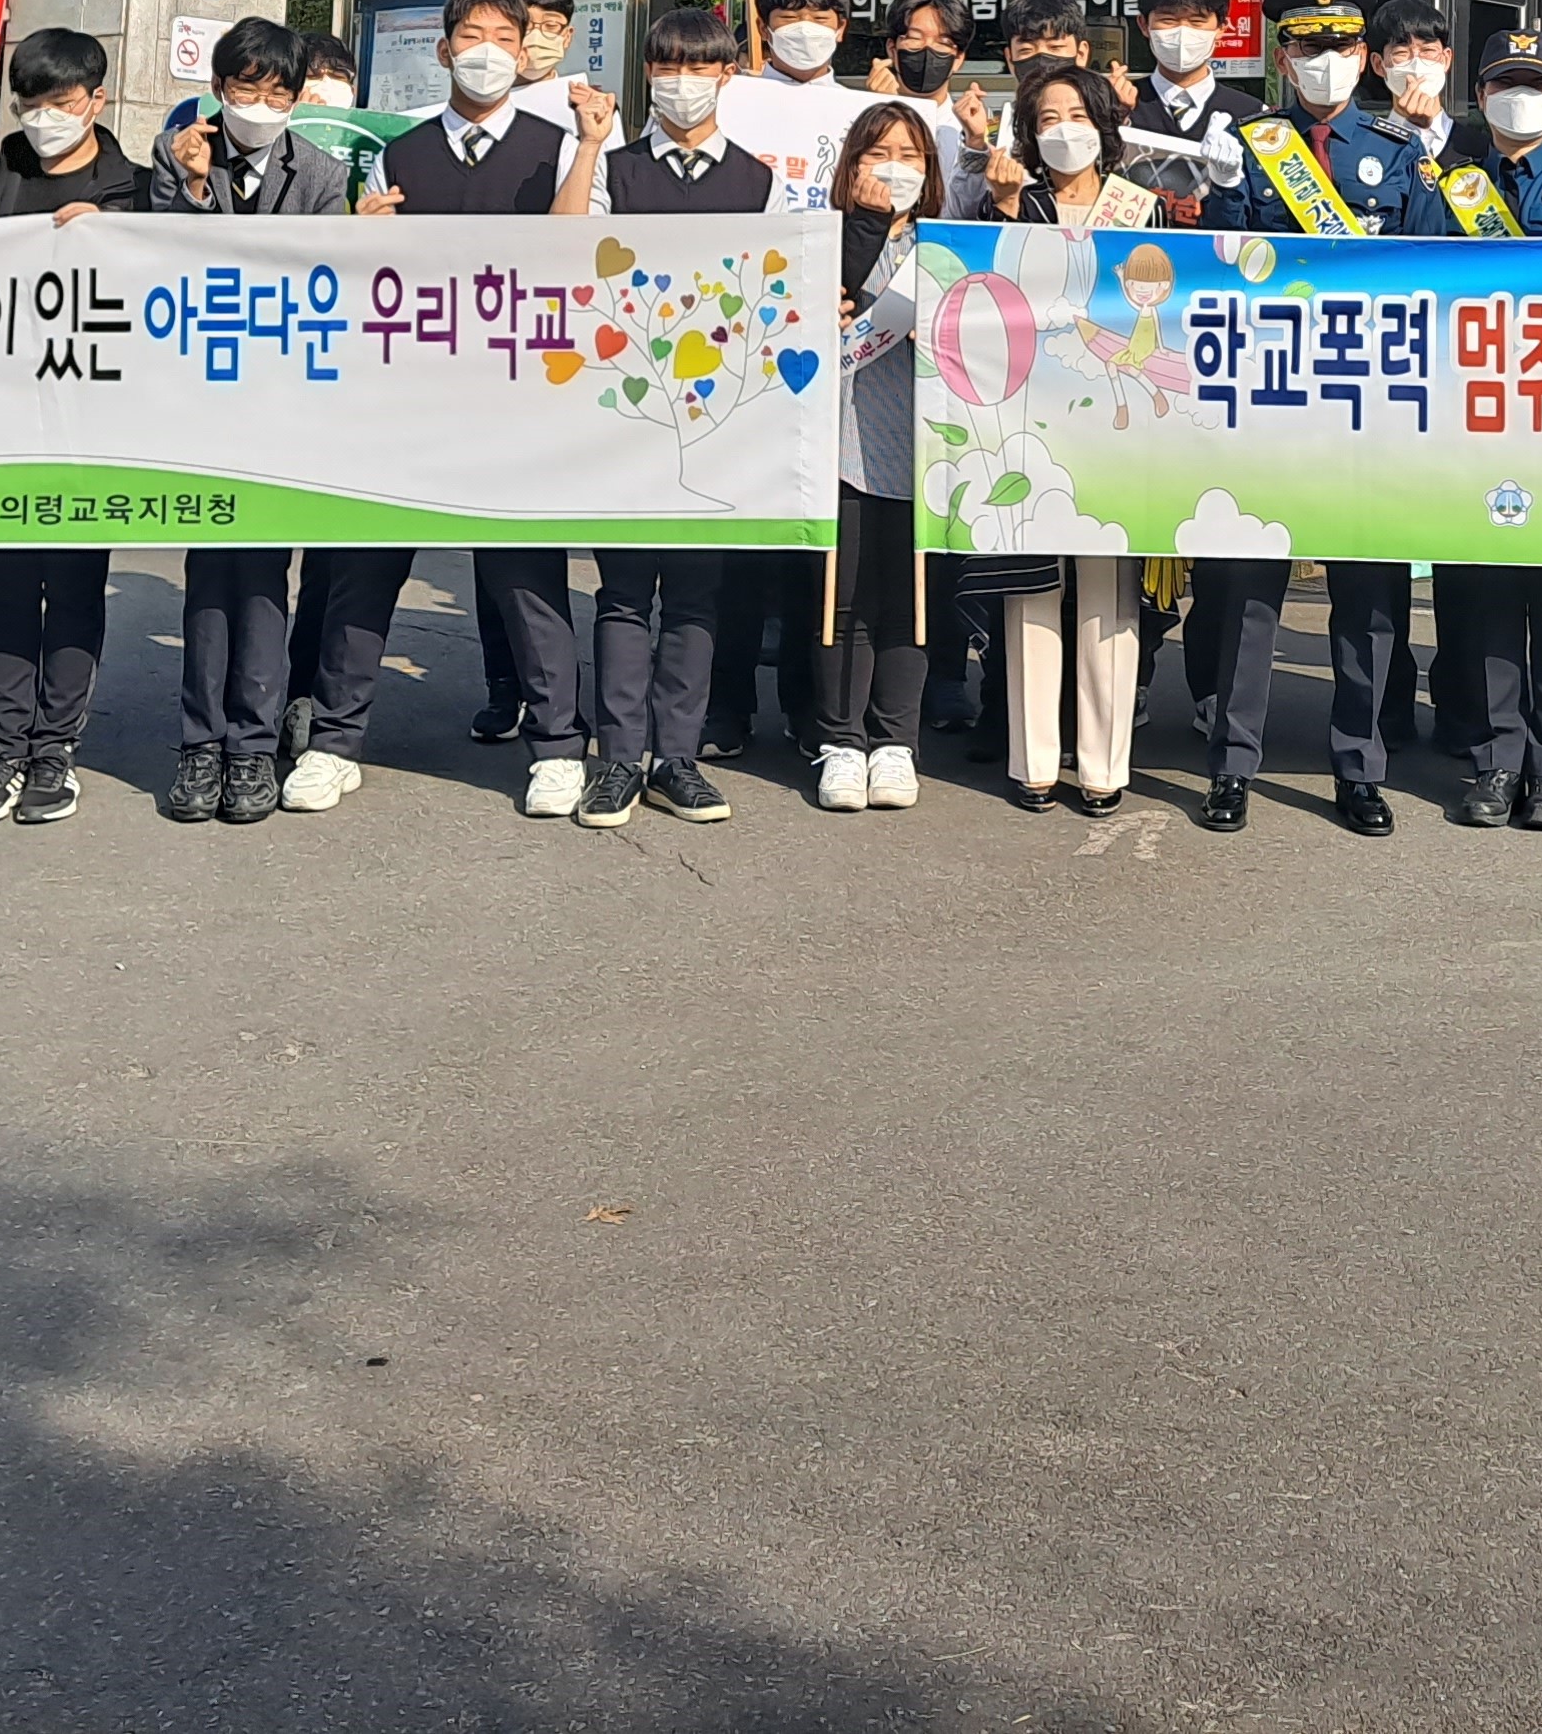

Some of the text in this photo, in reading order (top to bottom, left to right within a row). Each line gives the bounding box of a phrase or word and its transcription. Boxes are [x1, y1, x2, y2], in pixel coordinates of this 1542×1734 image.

[34, 267, 132, 381] 있는
[143, 264, 349, 381] 아름다운
[362, 266, 457, 365] 우리
[472, 263, 575, 381] 학교
[1189, 296, 1430, 433] 학교폭력
